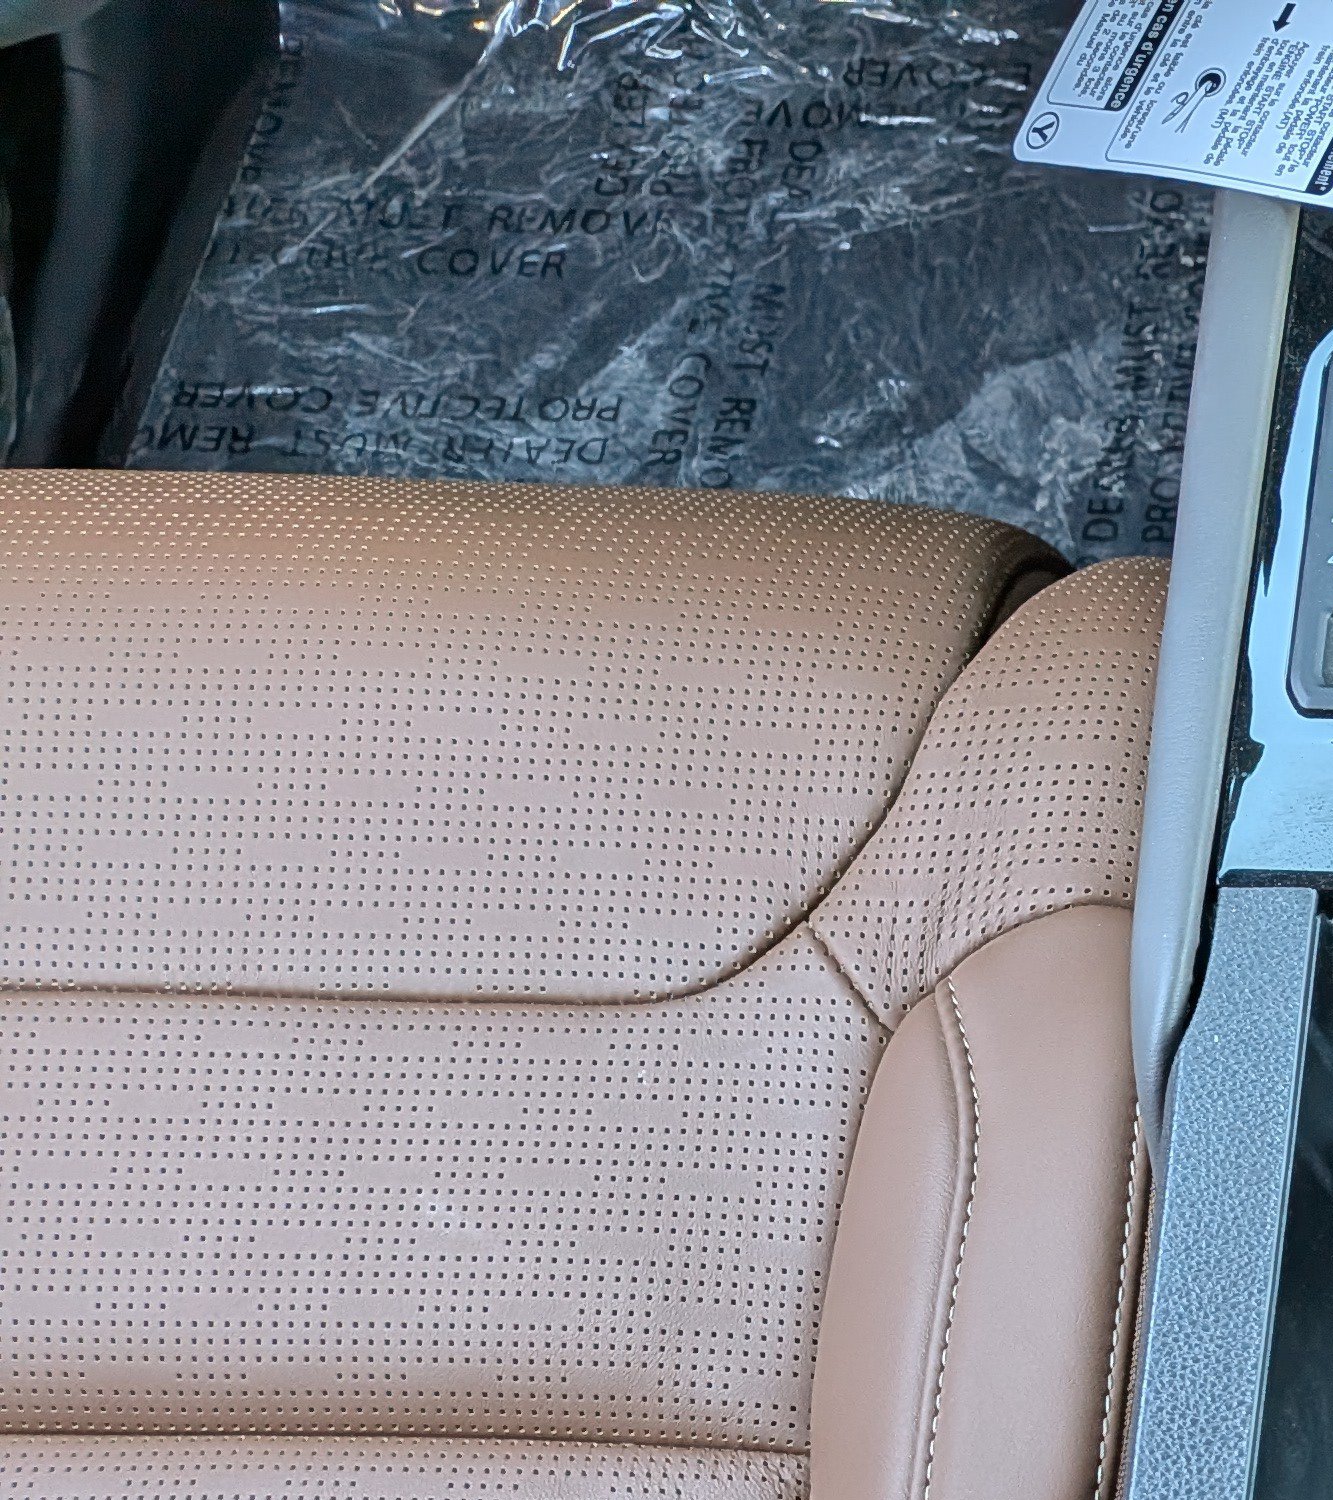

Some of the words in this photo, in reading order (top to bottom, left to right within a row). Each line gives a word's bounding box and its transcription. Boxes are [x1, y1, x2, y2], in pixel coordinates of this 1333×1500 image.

[1147, 15, 1168, 39] cas
[1109, 41, 1154, 109] d'urgence
[416, 246, 567, 279] COVER
[643, 351, 712, 467] COVER
